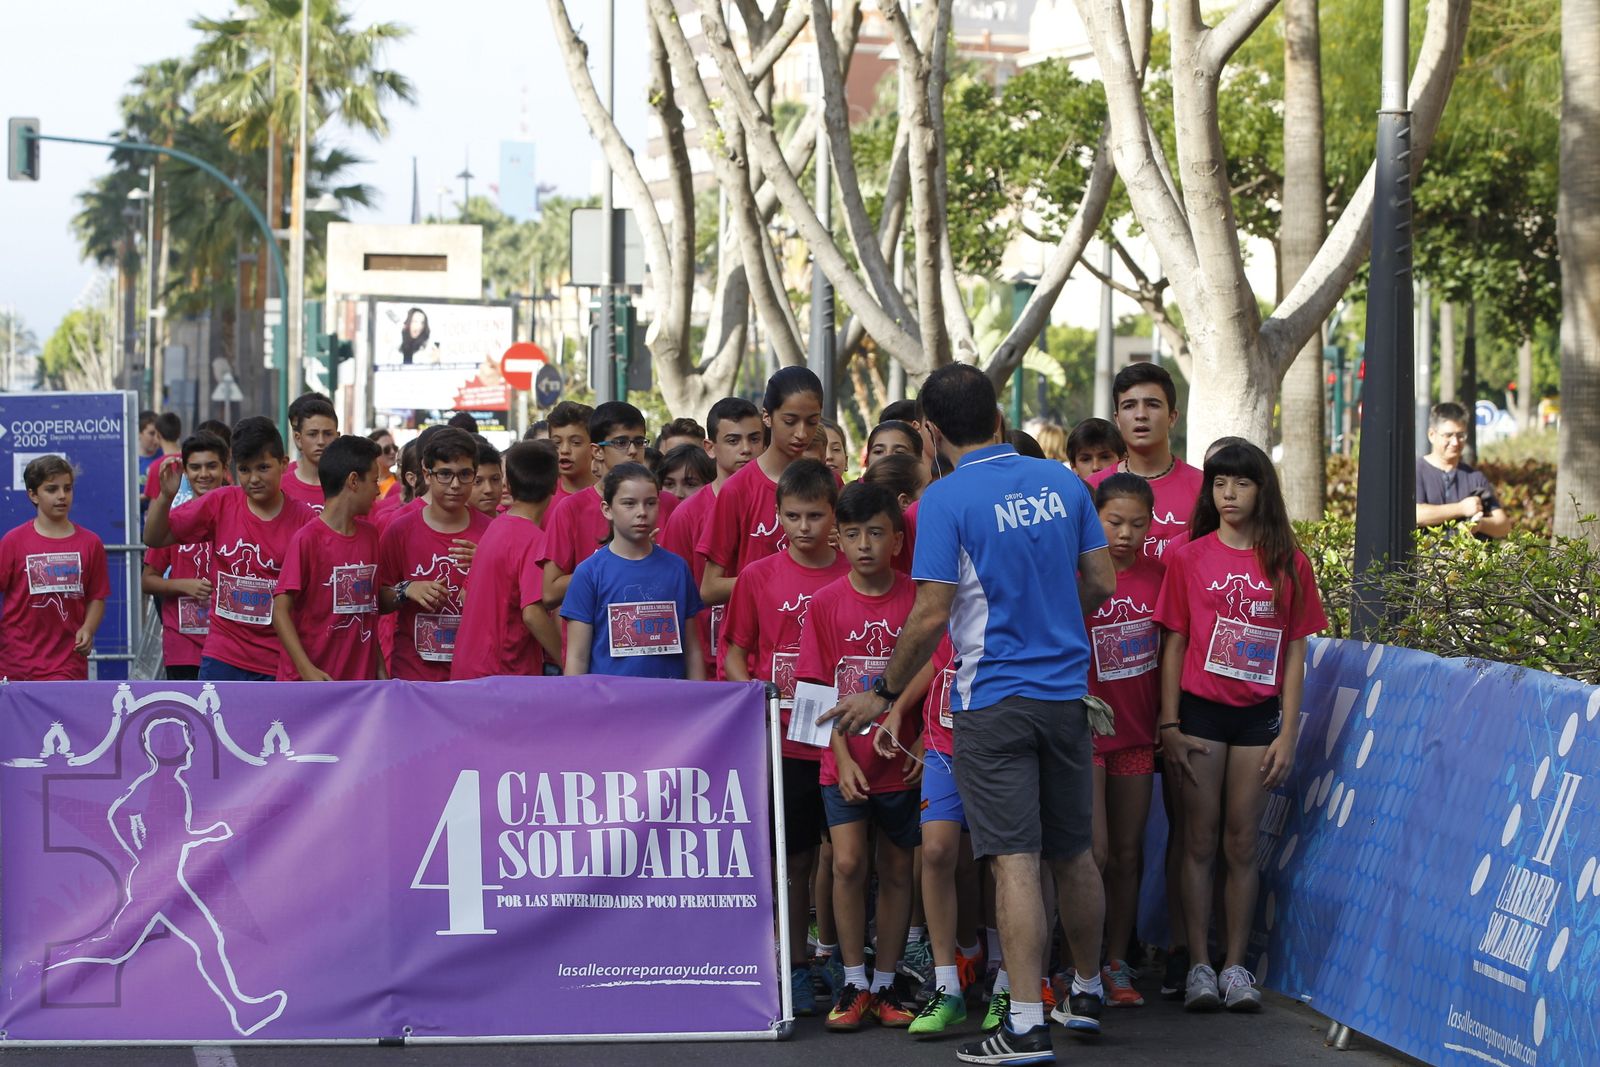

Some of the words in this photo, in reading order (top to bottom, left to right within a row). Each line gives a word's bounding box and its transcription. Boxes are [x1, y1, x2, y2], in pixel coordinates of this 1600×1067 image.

[11, 416, 120, 433] COOPERACIÓN
[14, 434, 47, 447] 2005
[1004, 492, 1023, 501] GRUPO
[994, 490, 1067, 533] NEXA
[1248, 600, 1256, 617] 4
[632, 617, 675, 635] 1873
[1532, 771, 1583, 866] II
[410, 769, 503, 935] 4
[497, 767, 752, 826] CARRERA
[498, 827, 755, 880] SOLIDARIA
[496, 894, 523, 908] POR
[525, 894, 549, 908] LAS
[551, 893, 644, 909] ENFERMEDADES
[646, 895, 678, 908] POCO
[680, 894, 758, 908] FRECUENTES
[1495, 863, 1562, 928] CARRERA
[1478, 911, 1543, 972] SOLIDARIA
[557, 962, 758, 981] lasallecorreparaayudar.com
